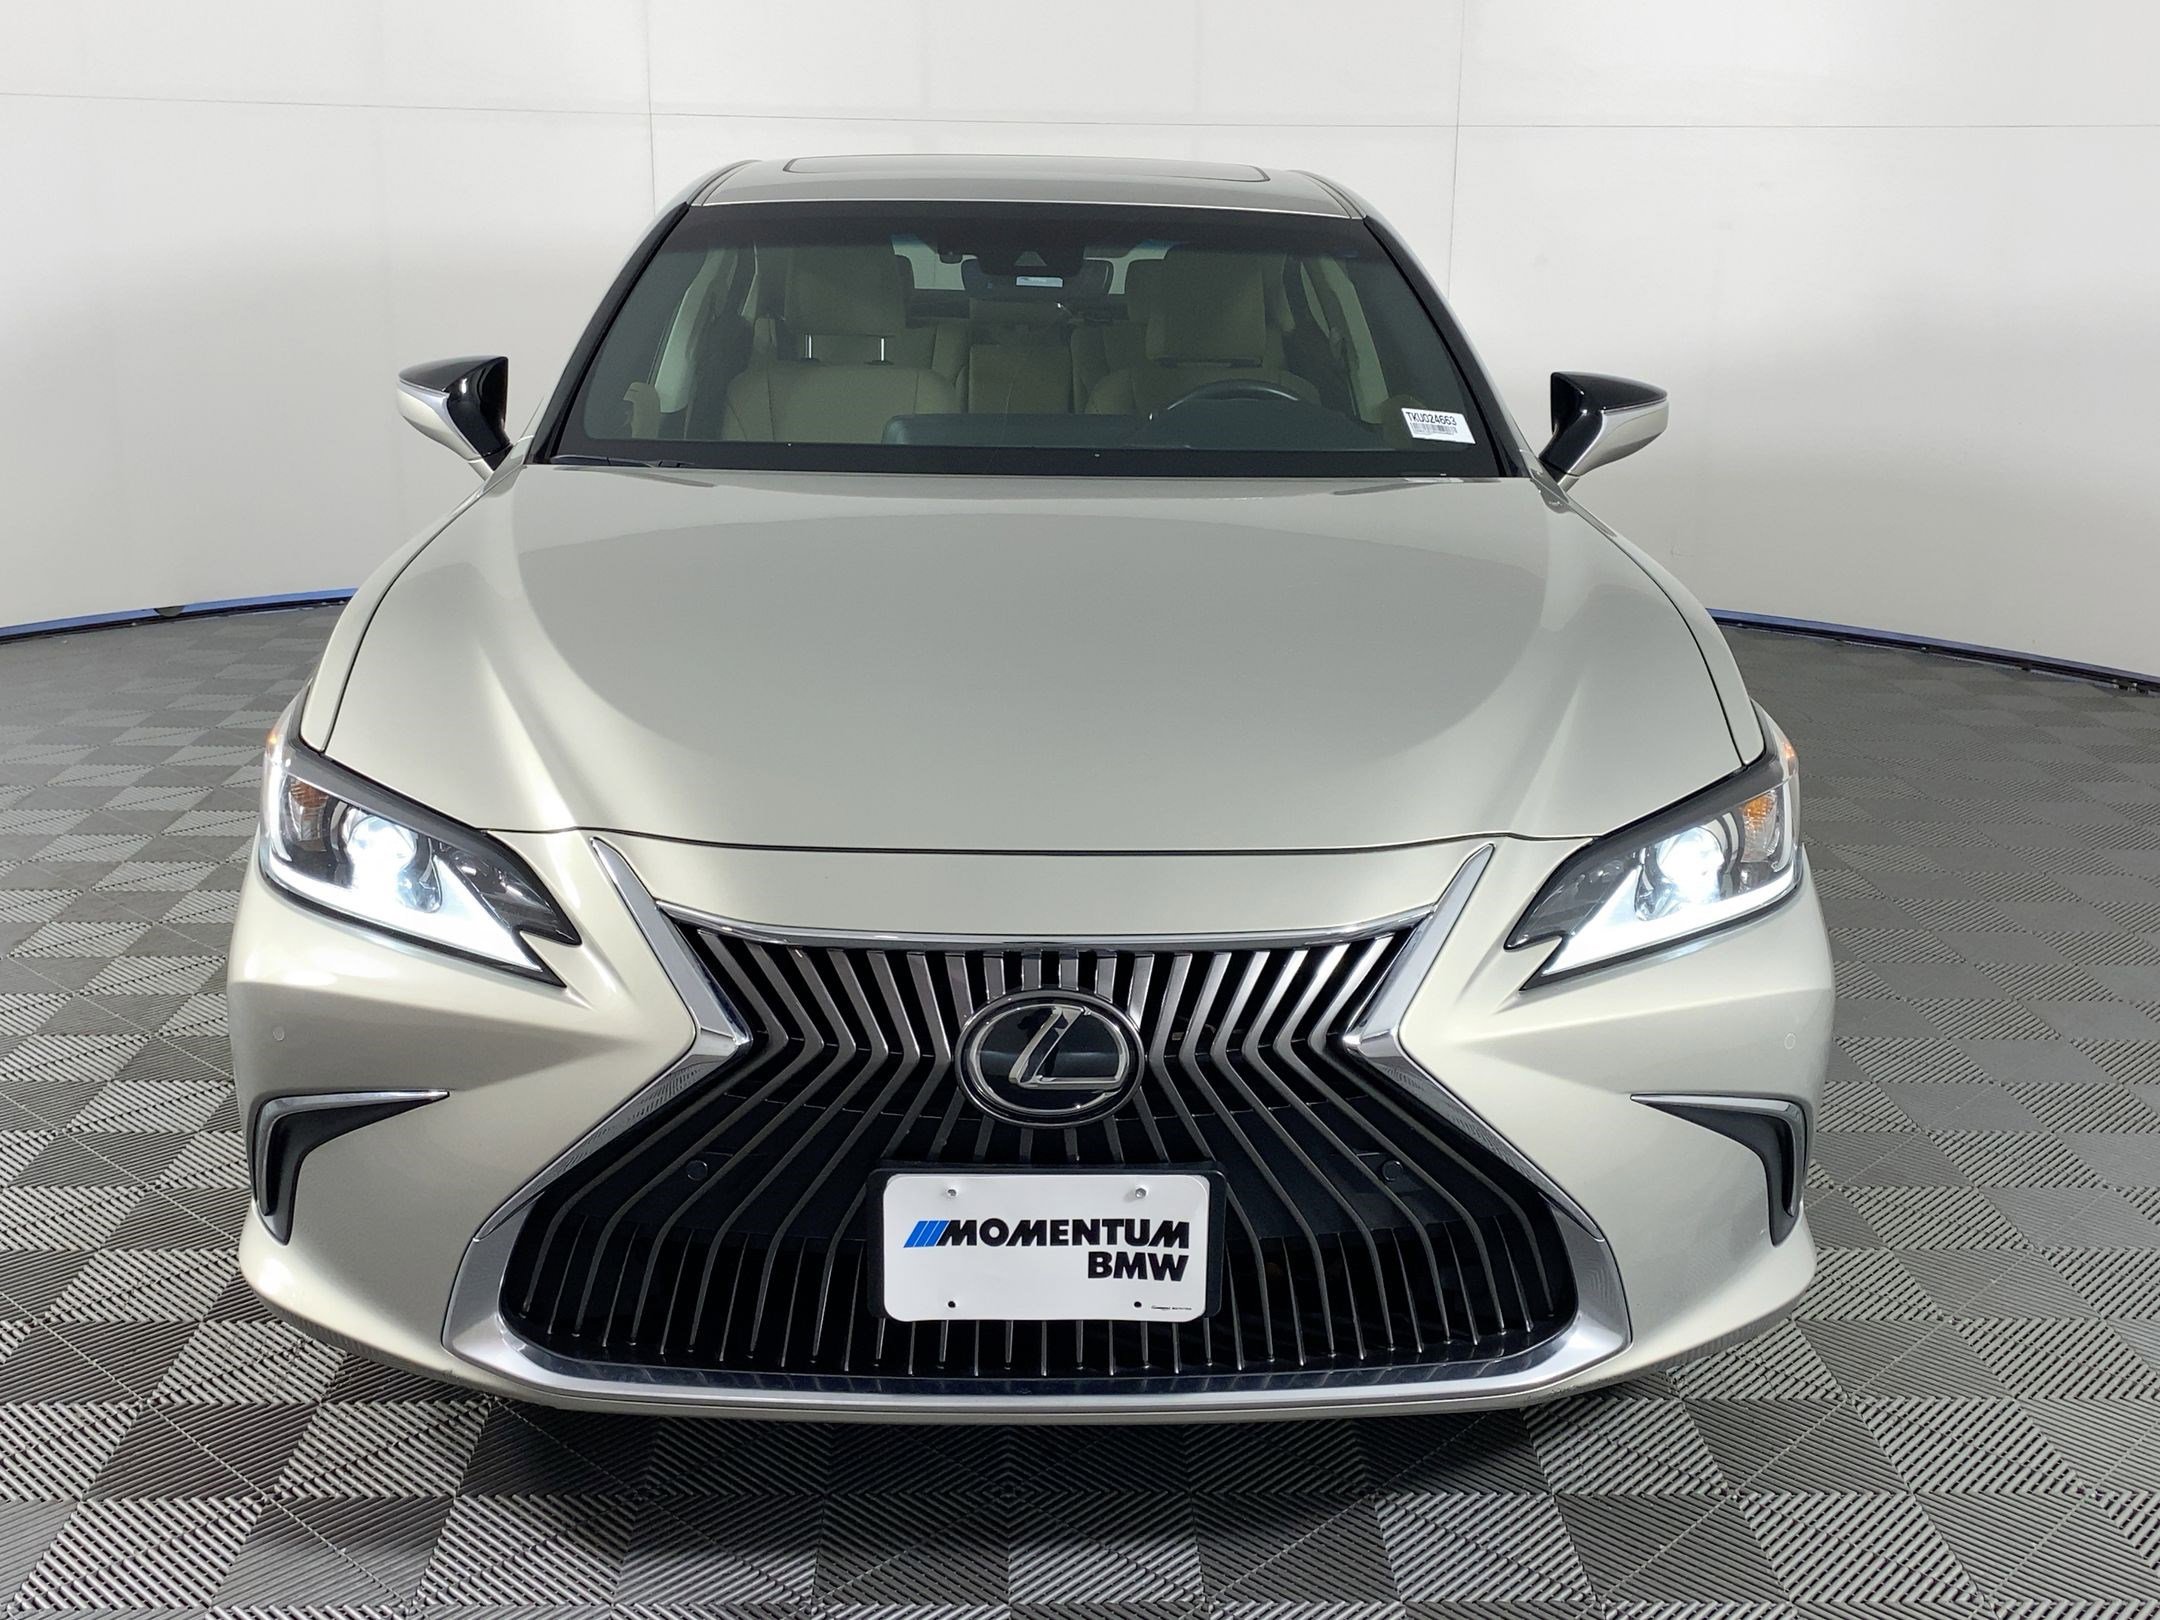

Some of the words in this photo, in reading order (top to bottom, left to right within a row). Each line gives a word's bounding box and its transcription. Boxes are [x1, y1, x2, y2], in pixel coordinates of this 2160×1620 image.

[1405, 411, 1457, 425] TKU024663
[935, 1217, 1190, 1249] MOMENTUM
[1087, 1250, 1190, 1282] BMW
